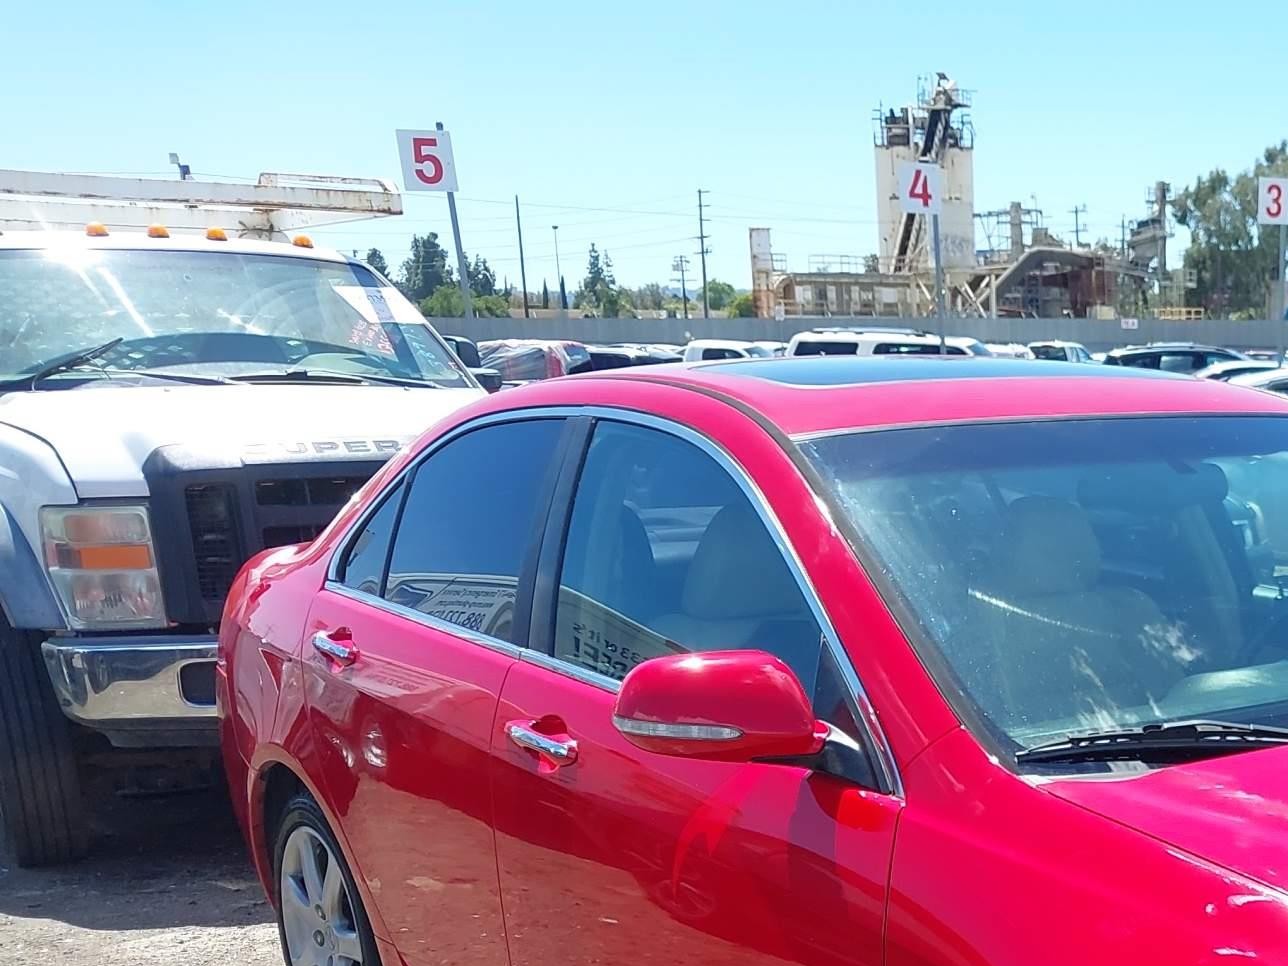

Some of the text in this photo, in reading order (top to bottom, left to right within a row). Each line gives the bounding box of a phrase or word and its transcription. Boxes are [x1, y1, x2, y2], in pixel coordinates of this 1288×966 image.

[412, 137, 443, 184] 5
[909, 169, 932, 207] 4
[1266, 184, 1281, 218] 3
